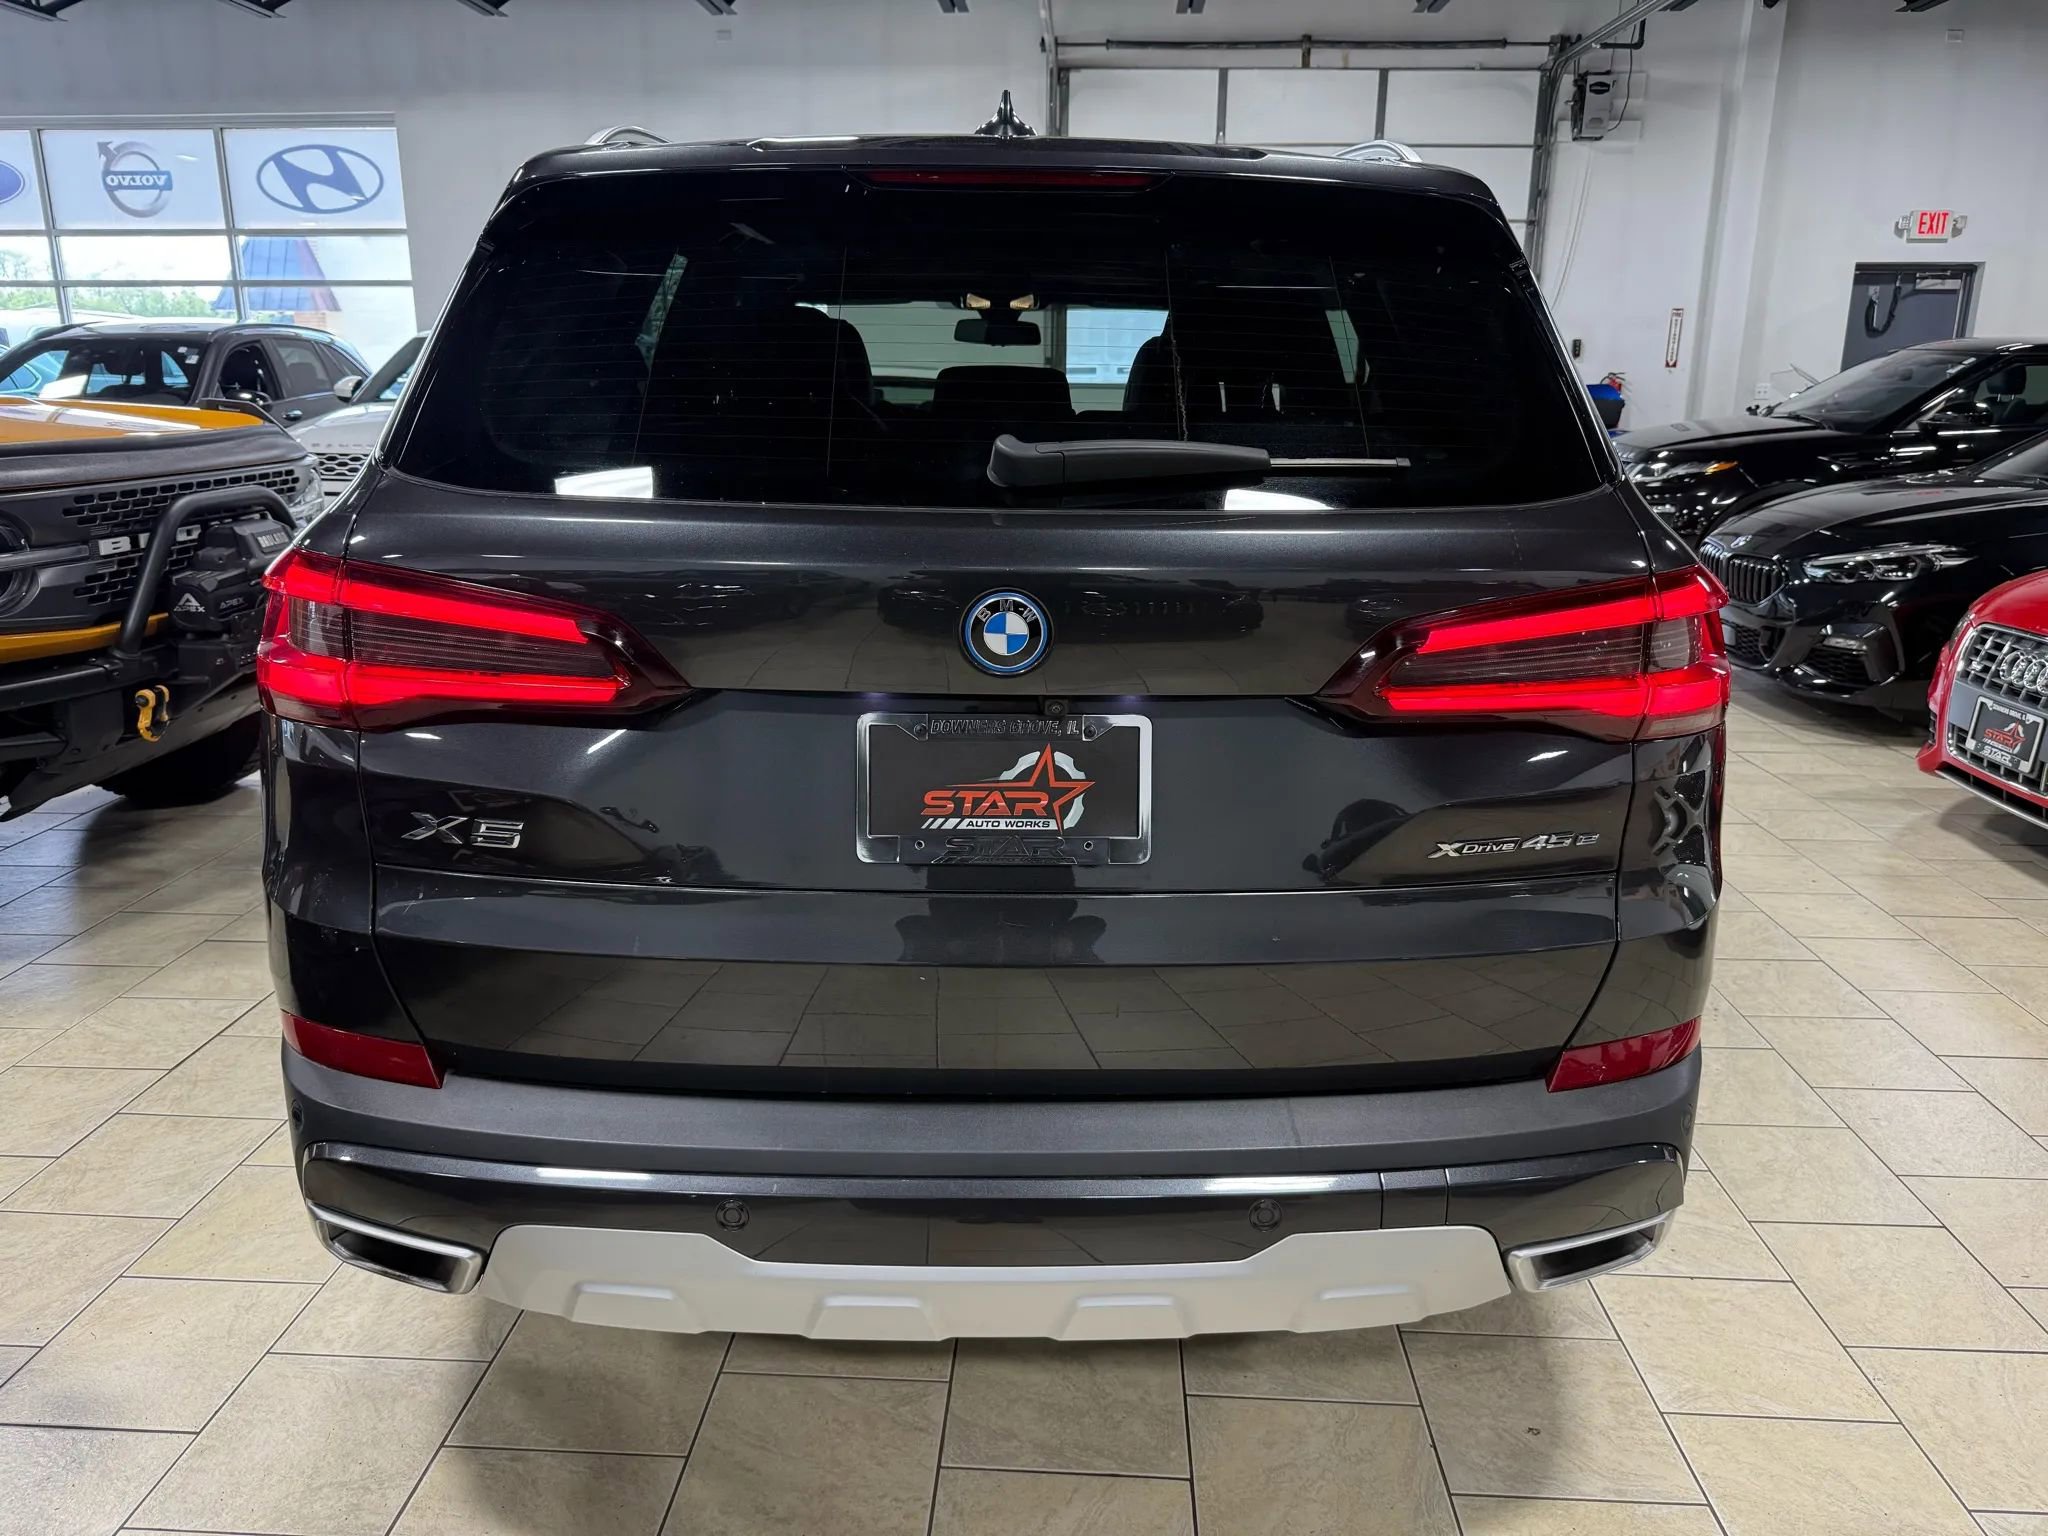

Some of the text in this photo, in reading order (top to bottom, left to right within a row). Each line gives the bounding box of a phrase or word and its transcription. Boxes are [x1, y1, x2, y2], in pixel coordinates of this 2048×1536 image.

[1917, 211, 1949, 235] EXIT
[976, 599, 1037, 623] BMW
[920, 790, 1049, 816] STAR
[400, 811, 524, 849] X5
[965, 820, 1050, 828] AUTO WORKS
